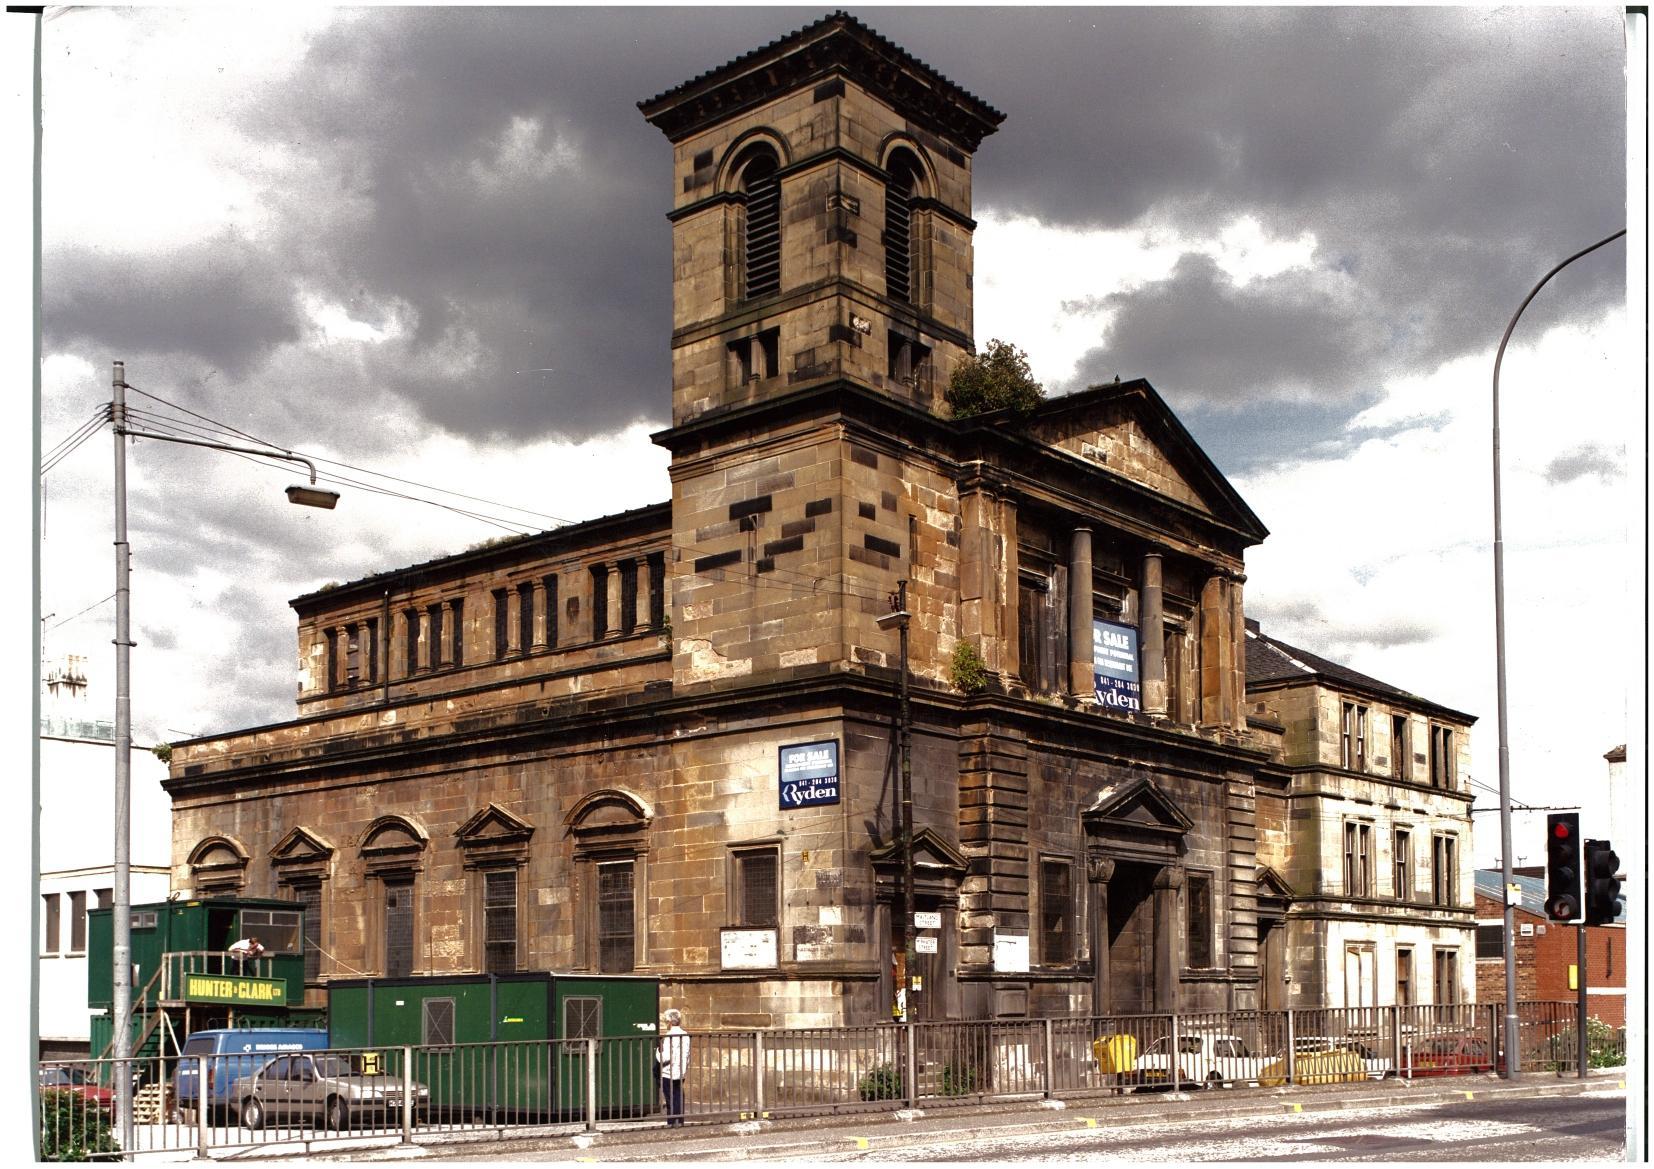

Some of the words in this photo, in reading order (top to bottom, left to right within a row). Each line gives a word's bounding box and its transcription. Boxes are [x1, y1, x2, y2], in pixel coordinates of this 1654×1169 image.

[1103, 631, 1129, 649] SALE
[788, 752, 805, 763] FOR
[807, 749, 829, 761] SALE
[782, 784, 837, 805] Ryden
[189, 978, 233, 998] HUNTER
[238, 982, 273, 1000] CLARK
[364, 1056, 378, 1072] H
